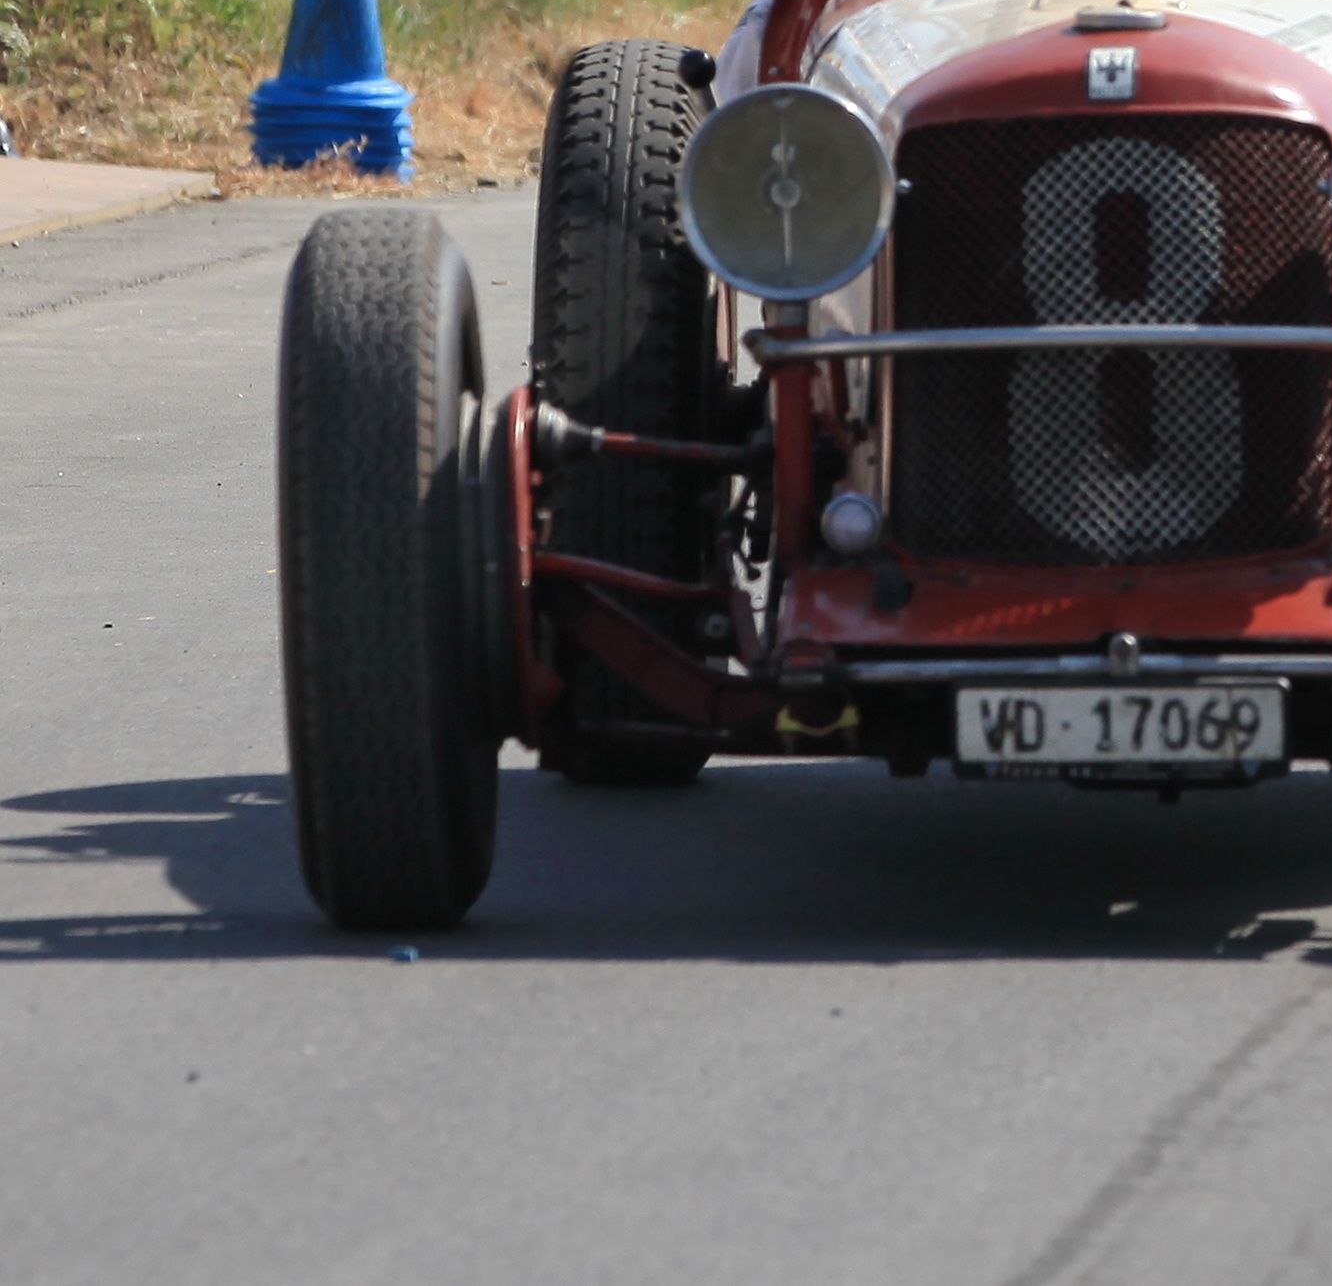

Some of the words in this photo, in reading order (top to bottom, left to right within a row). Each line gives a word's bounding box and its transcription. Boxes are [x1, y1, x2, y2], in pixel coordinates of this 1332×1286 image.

[1007, 136, 1243, 562] 8
[979, 697, 1045, 754] VD
[1093, 697, 1260, 753] 17069
